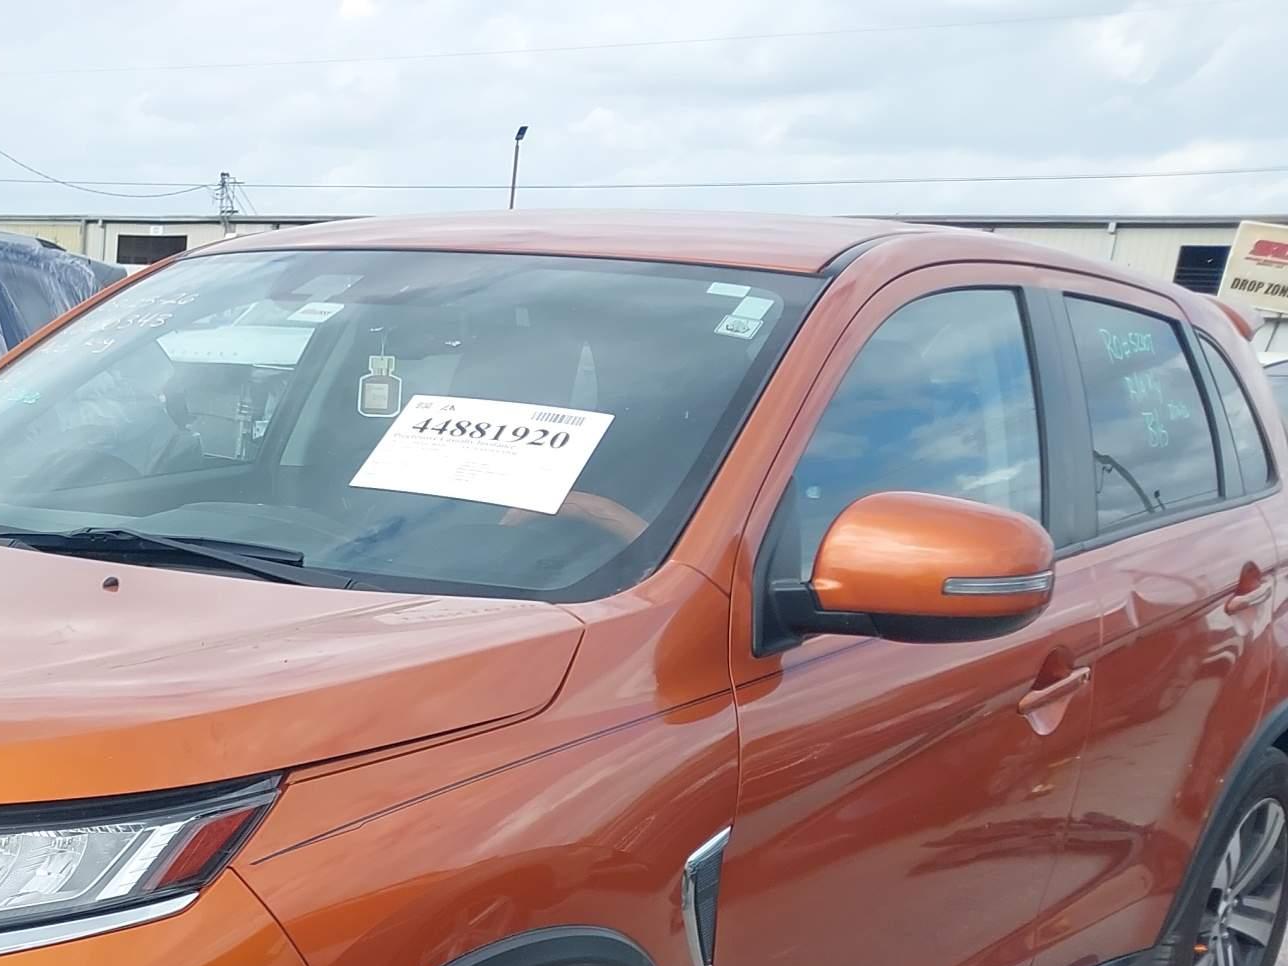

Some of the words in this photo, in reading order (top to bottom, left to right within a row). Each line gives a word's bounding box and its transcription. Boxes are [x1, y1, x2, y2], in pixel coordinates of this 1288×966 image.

[1230, 277, 1264, 293] DROP
[1264, 282, 1288, 298] ZON
[411, 417, 571, 449] 44881920
